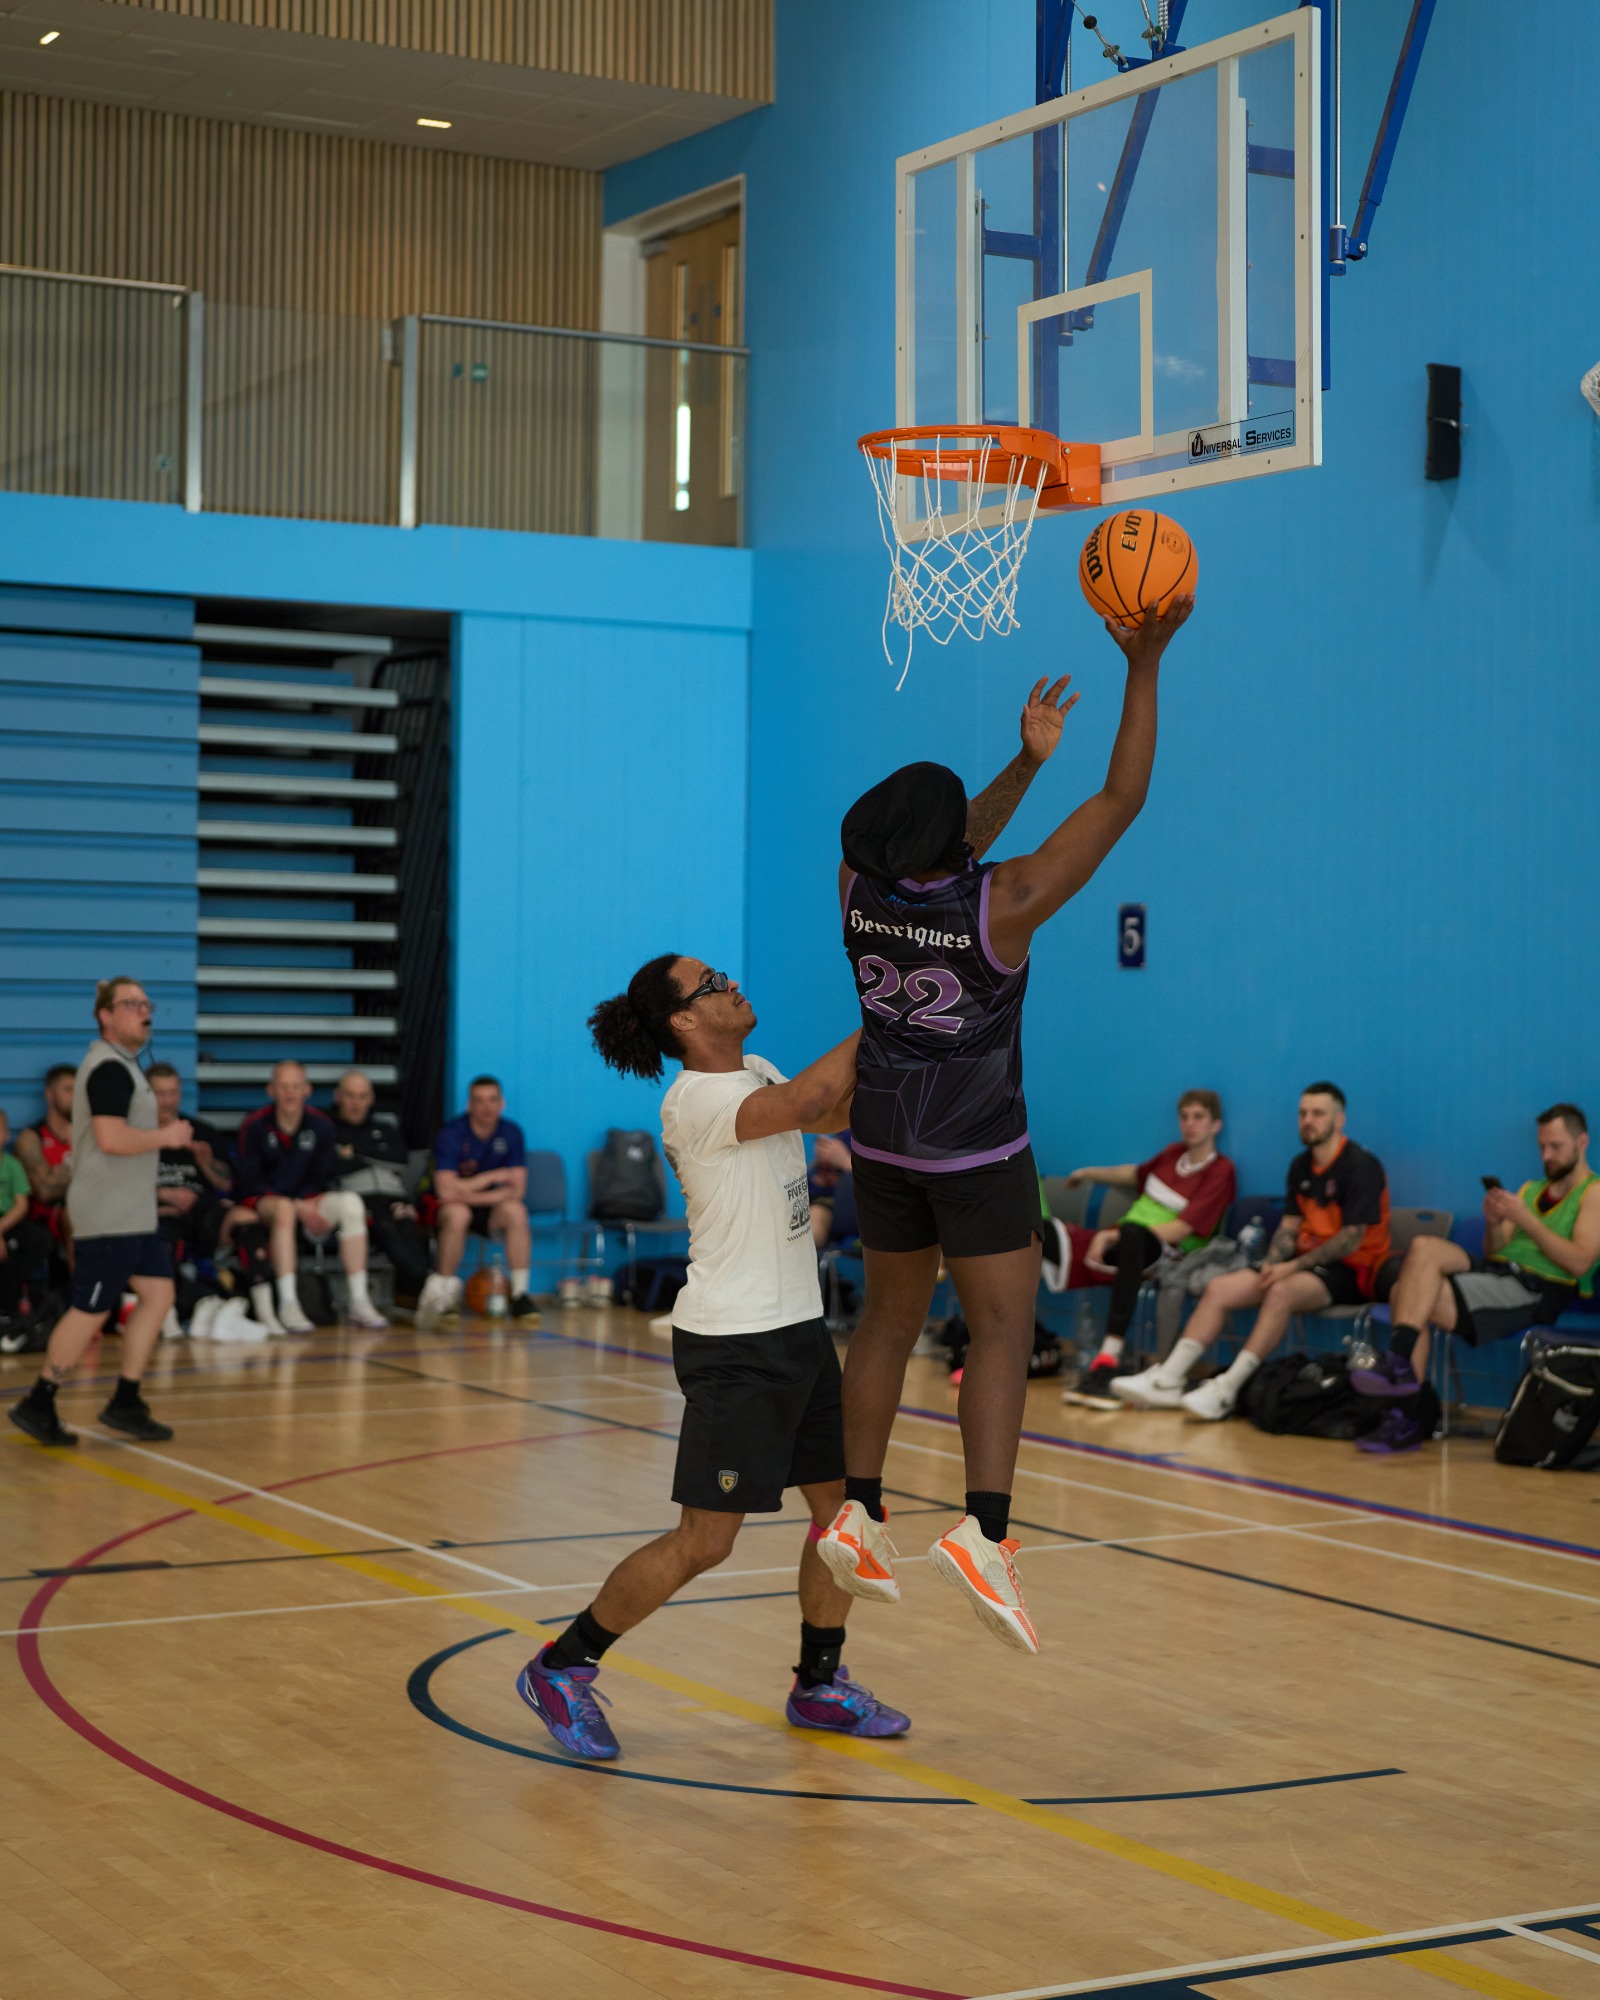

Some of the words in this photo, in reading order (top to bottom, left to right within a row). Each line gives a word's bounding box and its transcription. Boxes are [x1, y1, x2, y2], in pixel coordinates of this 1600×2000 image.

[1246, 427, 1291, 446] SERVICES
[850, 908, 972, 949] Henriques
[1122, 917, 1142, 956] 5
[858, 954, 965, 1034] 22
